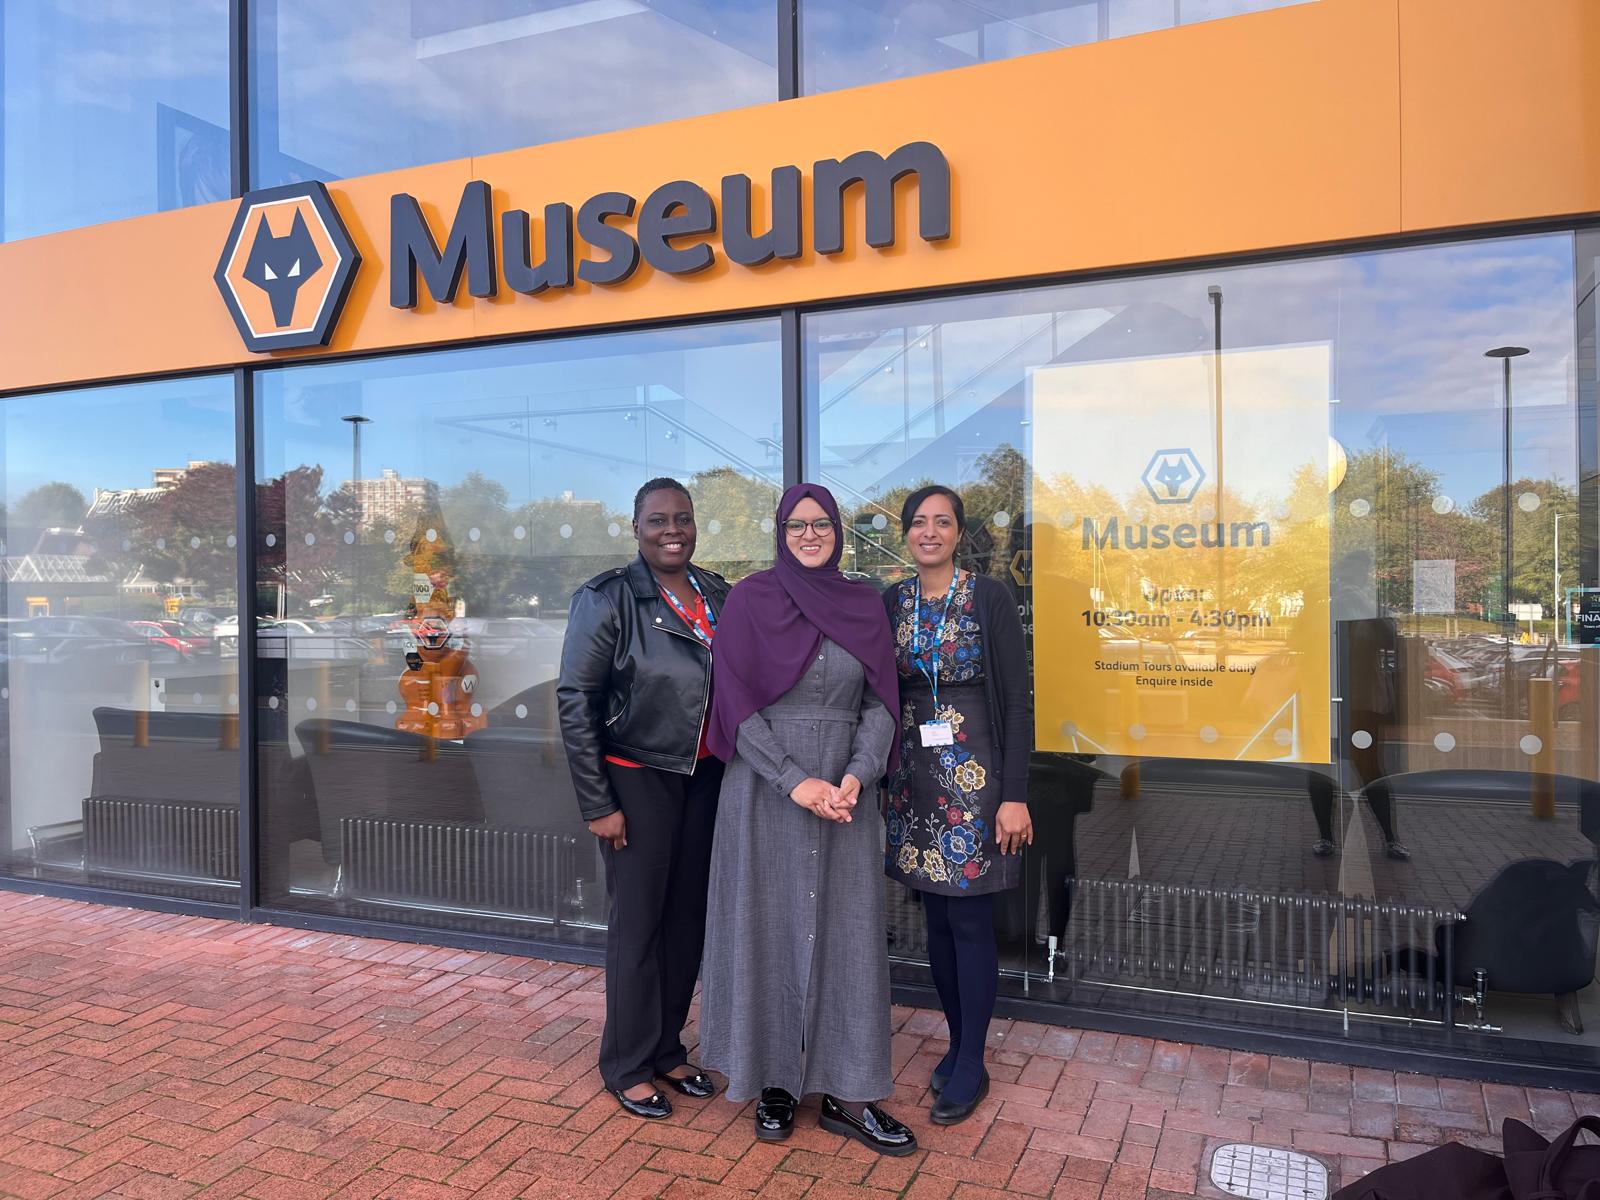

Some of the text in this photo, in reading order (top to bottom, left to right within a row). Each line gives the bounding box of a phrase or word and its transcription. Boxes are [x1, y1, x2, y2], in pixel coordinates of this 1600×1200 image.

[390, 141, 952, 310] Museum
[1082, 516, 1271, 550] Museum
[1081, 609, 1170, 628] 10:30am
[1190, 609, 1272, 630] 4:30pm
[1094, 660, 1257, 676] Stadium Tours available daily
[1135, 675, 1213, 688] Enquire inside
